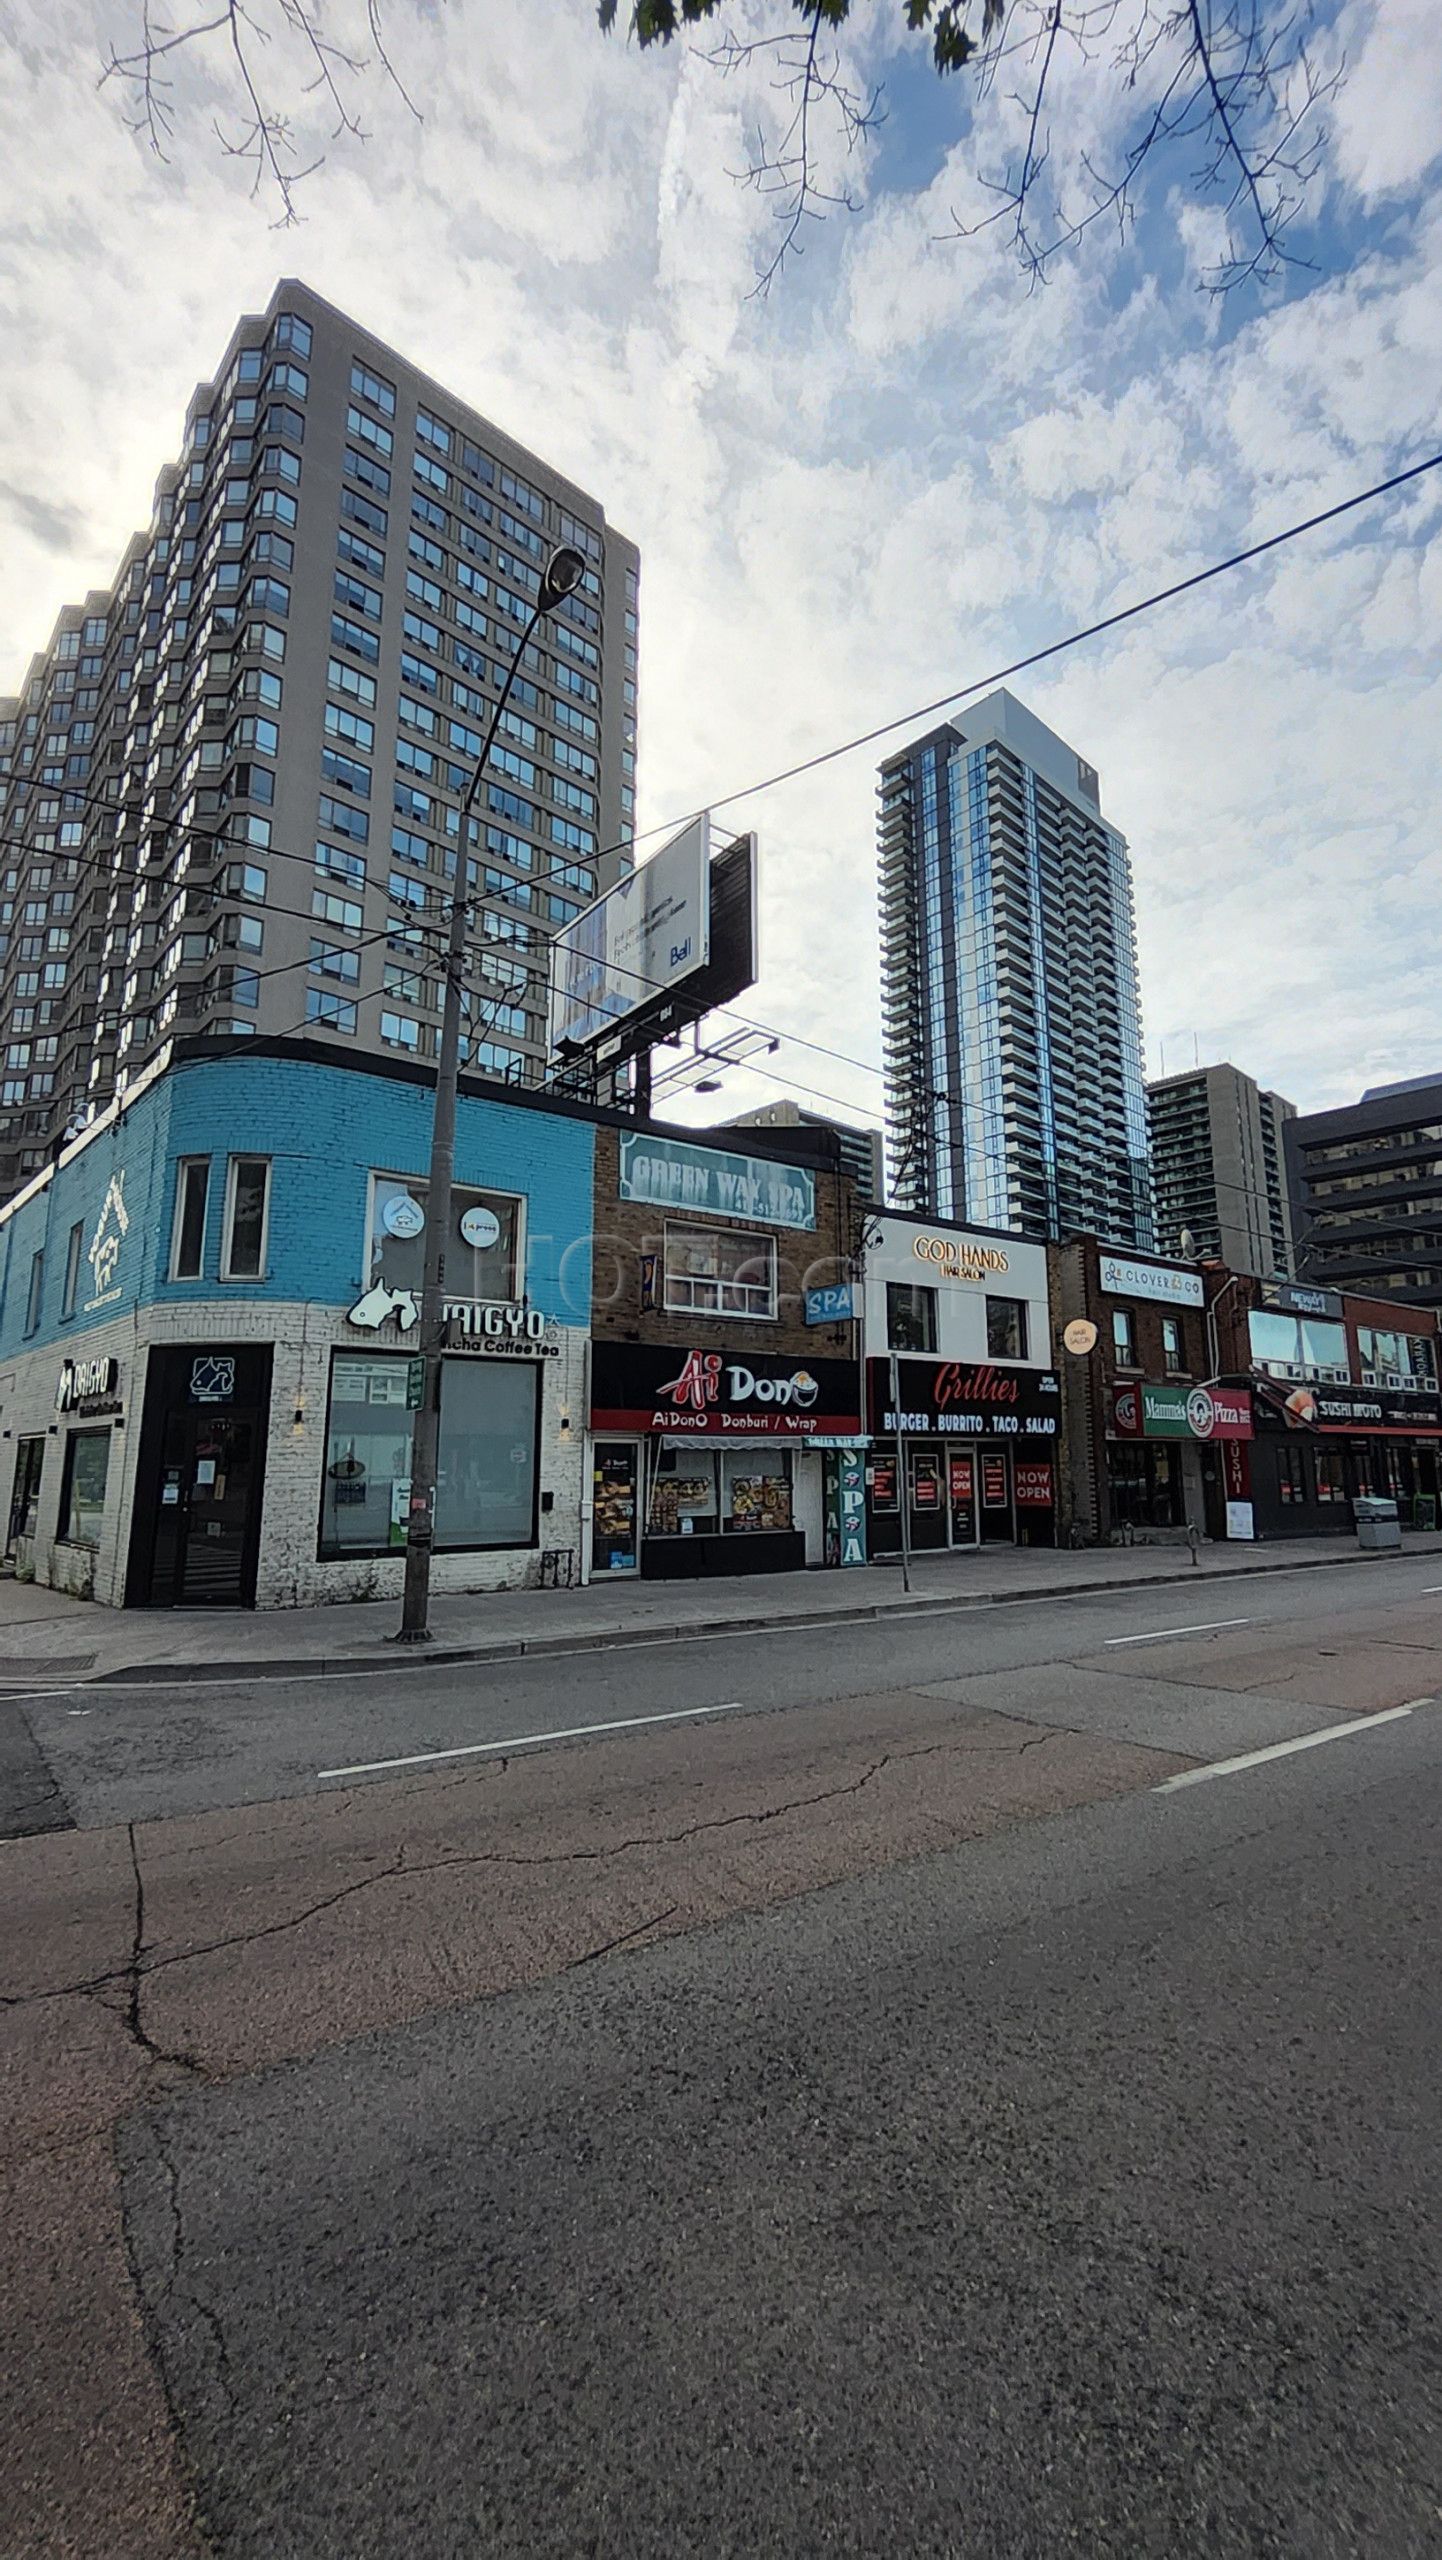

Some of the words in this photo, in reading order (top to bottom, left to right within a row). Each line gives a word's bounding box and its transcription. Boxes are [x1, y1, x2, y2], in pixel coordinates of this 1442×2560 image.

[914, 1236, 956, 1264] GOD
[960, 1244, 1009, 1275] HANDS
[941, 1265, 959, 1278] HAIR
[960, 1269, 985, 1282] SALON
[1126, 1269, 1170, 1289] CLOVER
[1184, 1281, 1200, 1294] CO
[808, 1287, 850, 1314] SPA
[484, 1339, 533, 1355] Coffee
[535, 1343, 560, 1357] Tea
[656, 1350, 722, 1410] Ai
[934, 1363, 1020, 1411] Grillies
[1318, 1400, 1351, 1416] SUSHI
[721, 1413, 769, 1429] Donburi
[785, 1416, 818, 1433] Wrap
[884, 1412, 929, 1431] BURGER
[938, 1414, 983, 1432] BURRITO
[993, 1416, 1018, 1433] TACO
[1026, 1417, 1055, 1434] SALAD
[952, 1480, 971, 1490] OPEN
[1016, 1471, 1050, 1484] NOW
[1016, 1486, 1050, 1500] OPEN
